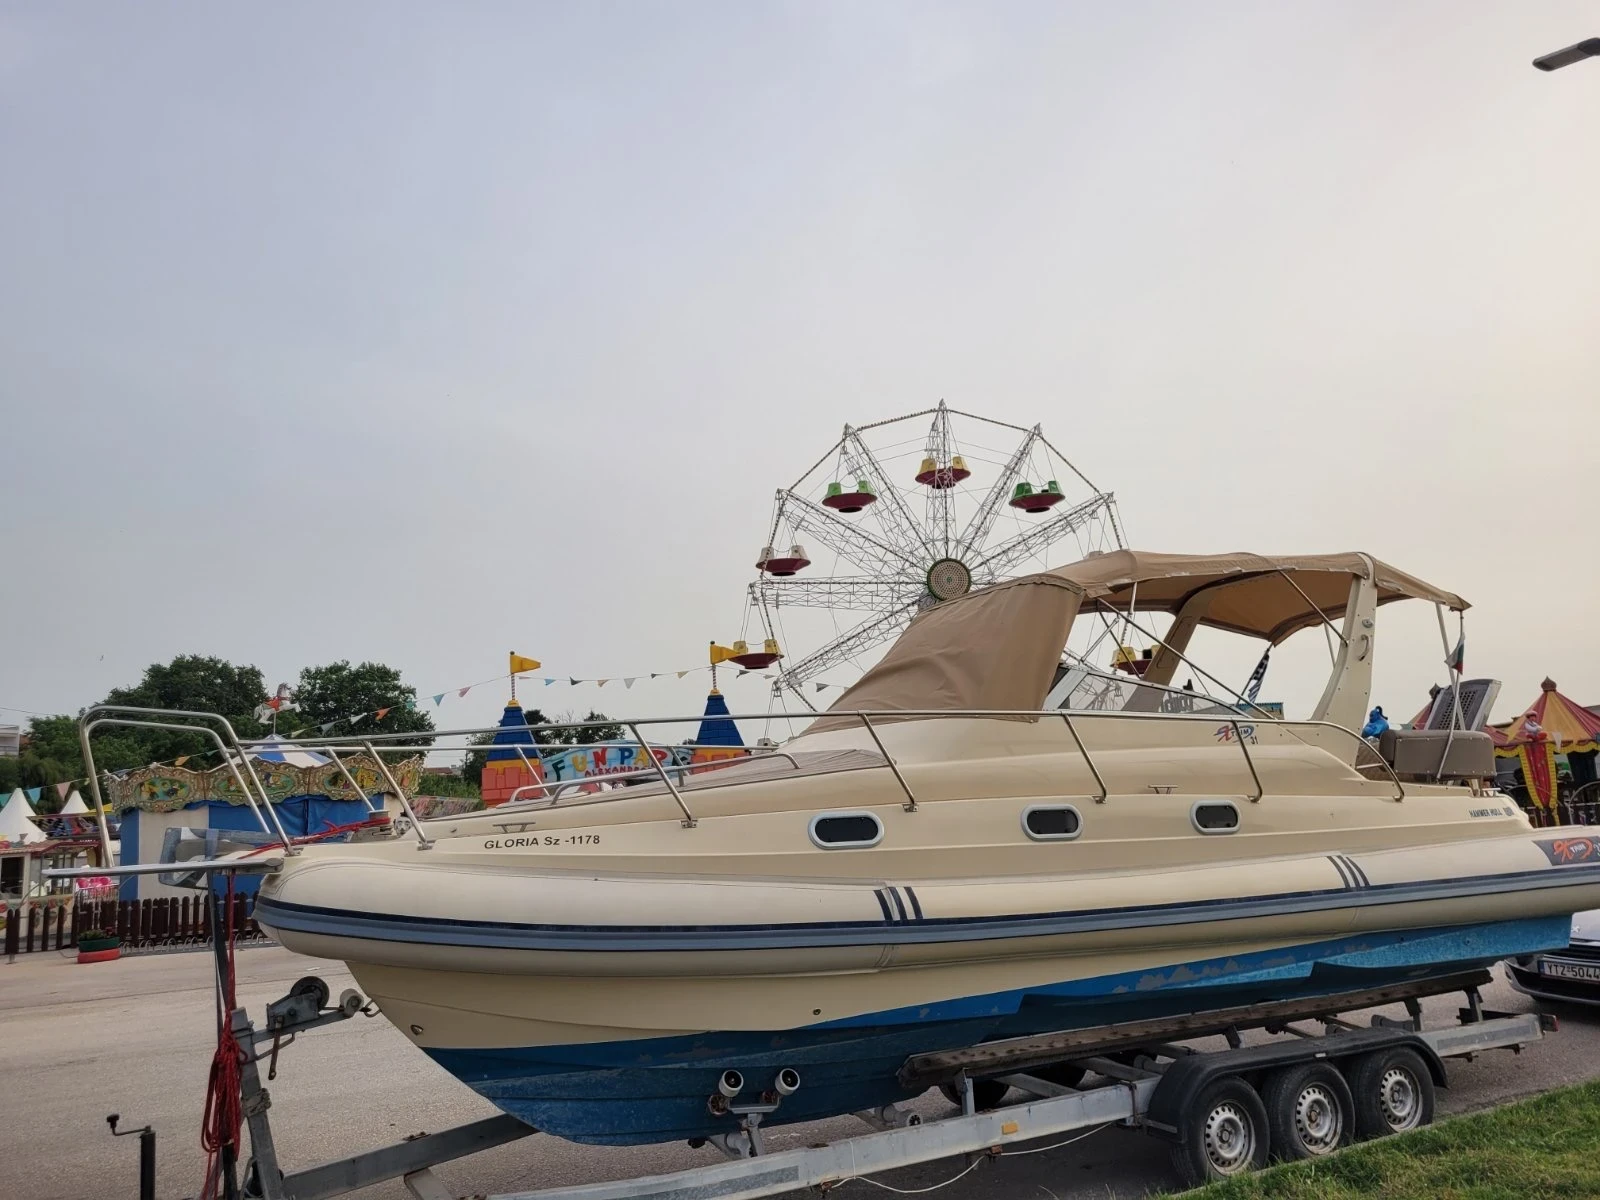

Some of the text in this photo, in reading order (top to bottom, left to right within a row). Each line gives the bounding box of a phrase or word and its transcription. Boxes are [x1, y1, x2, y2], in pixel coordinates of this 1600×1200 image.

[551, 746, 608, 782] FUN
[484, 834, 600, 850] GLORIA Sz -1178
